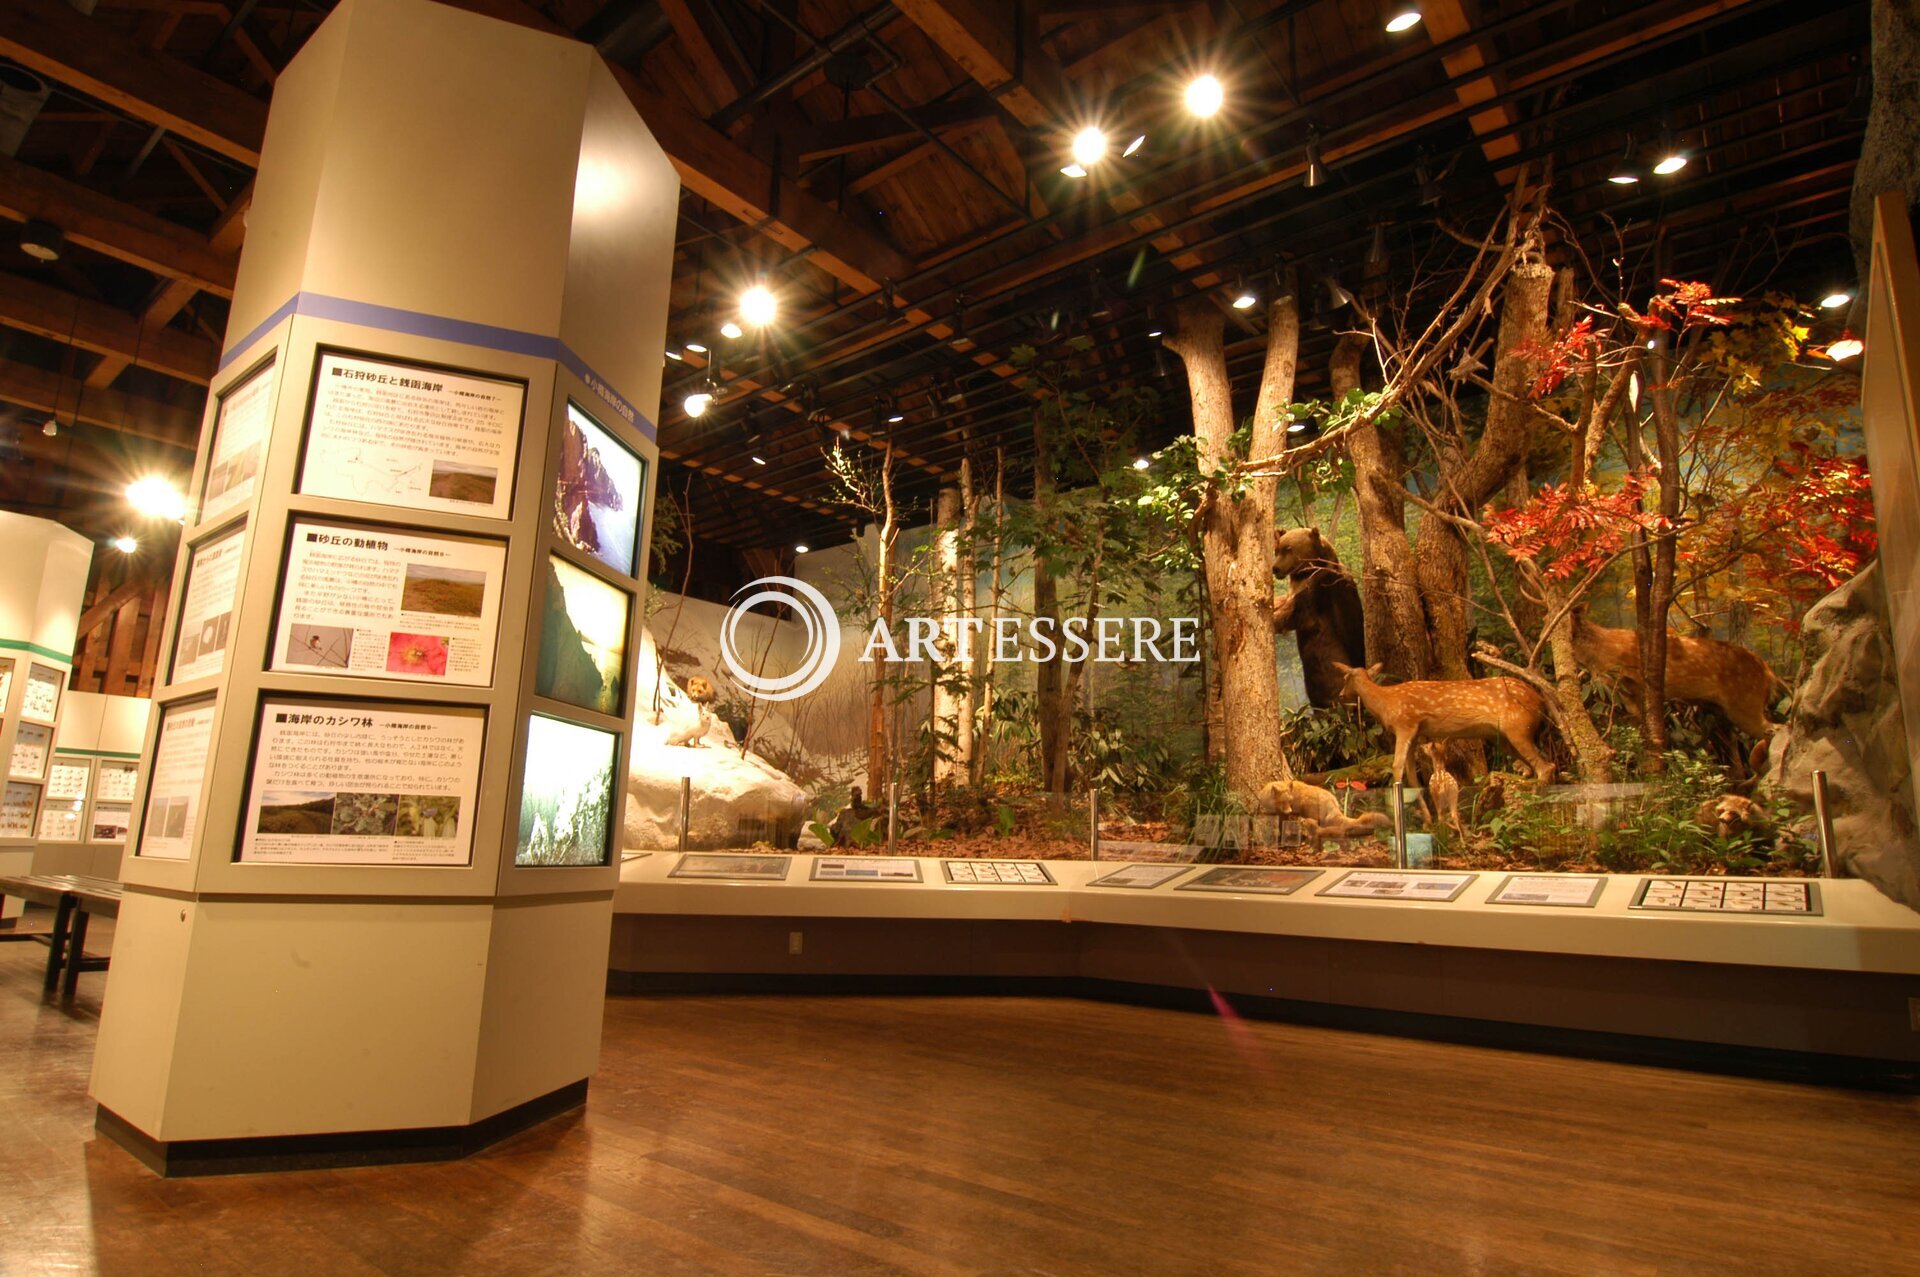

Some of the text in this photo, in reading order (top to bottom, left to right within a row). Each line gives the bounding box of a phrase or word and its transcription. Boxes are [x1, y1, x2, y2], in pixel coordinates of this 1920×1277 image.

[343, 369, 443, 392] 石狩砂丘と銭函海岸
[319, 534, 388, 552] 砂丘の動植物
[288, 713, 373, 728] 海岸のカシワ林
